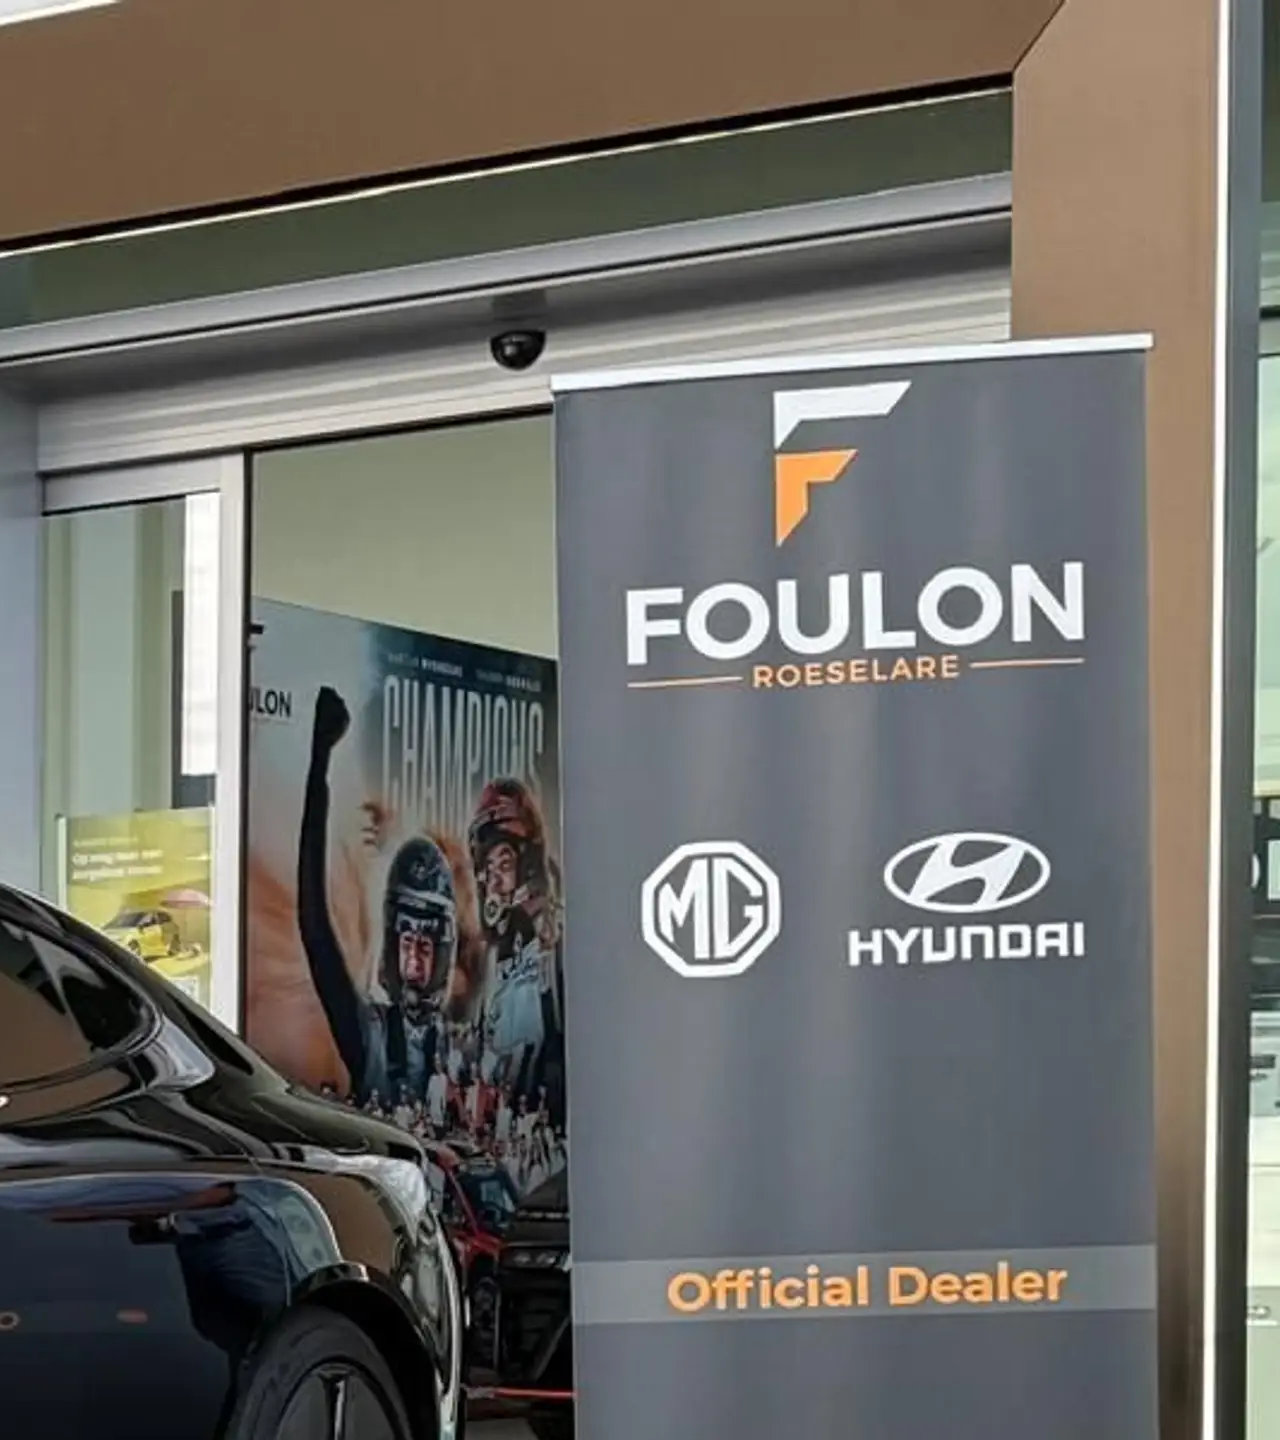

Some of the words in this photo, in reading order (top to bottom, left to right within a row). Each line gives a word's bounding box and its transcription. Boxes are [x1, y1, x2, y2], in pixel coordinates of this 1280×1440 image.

[626, 562, 1085, 666] FOULON
[752, 654, 961, 689] ROESELARE
[384, 674, 545, 815] CHAMPIONS
[654, 854, 766, 962] MG
[848, 922, 1086, 967] HYUNDAI
[667, 1264, 870, 1313] Official
[888, 1260, 1068, 1306] Dealer
